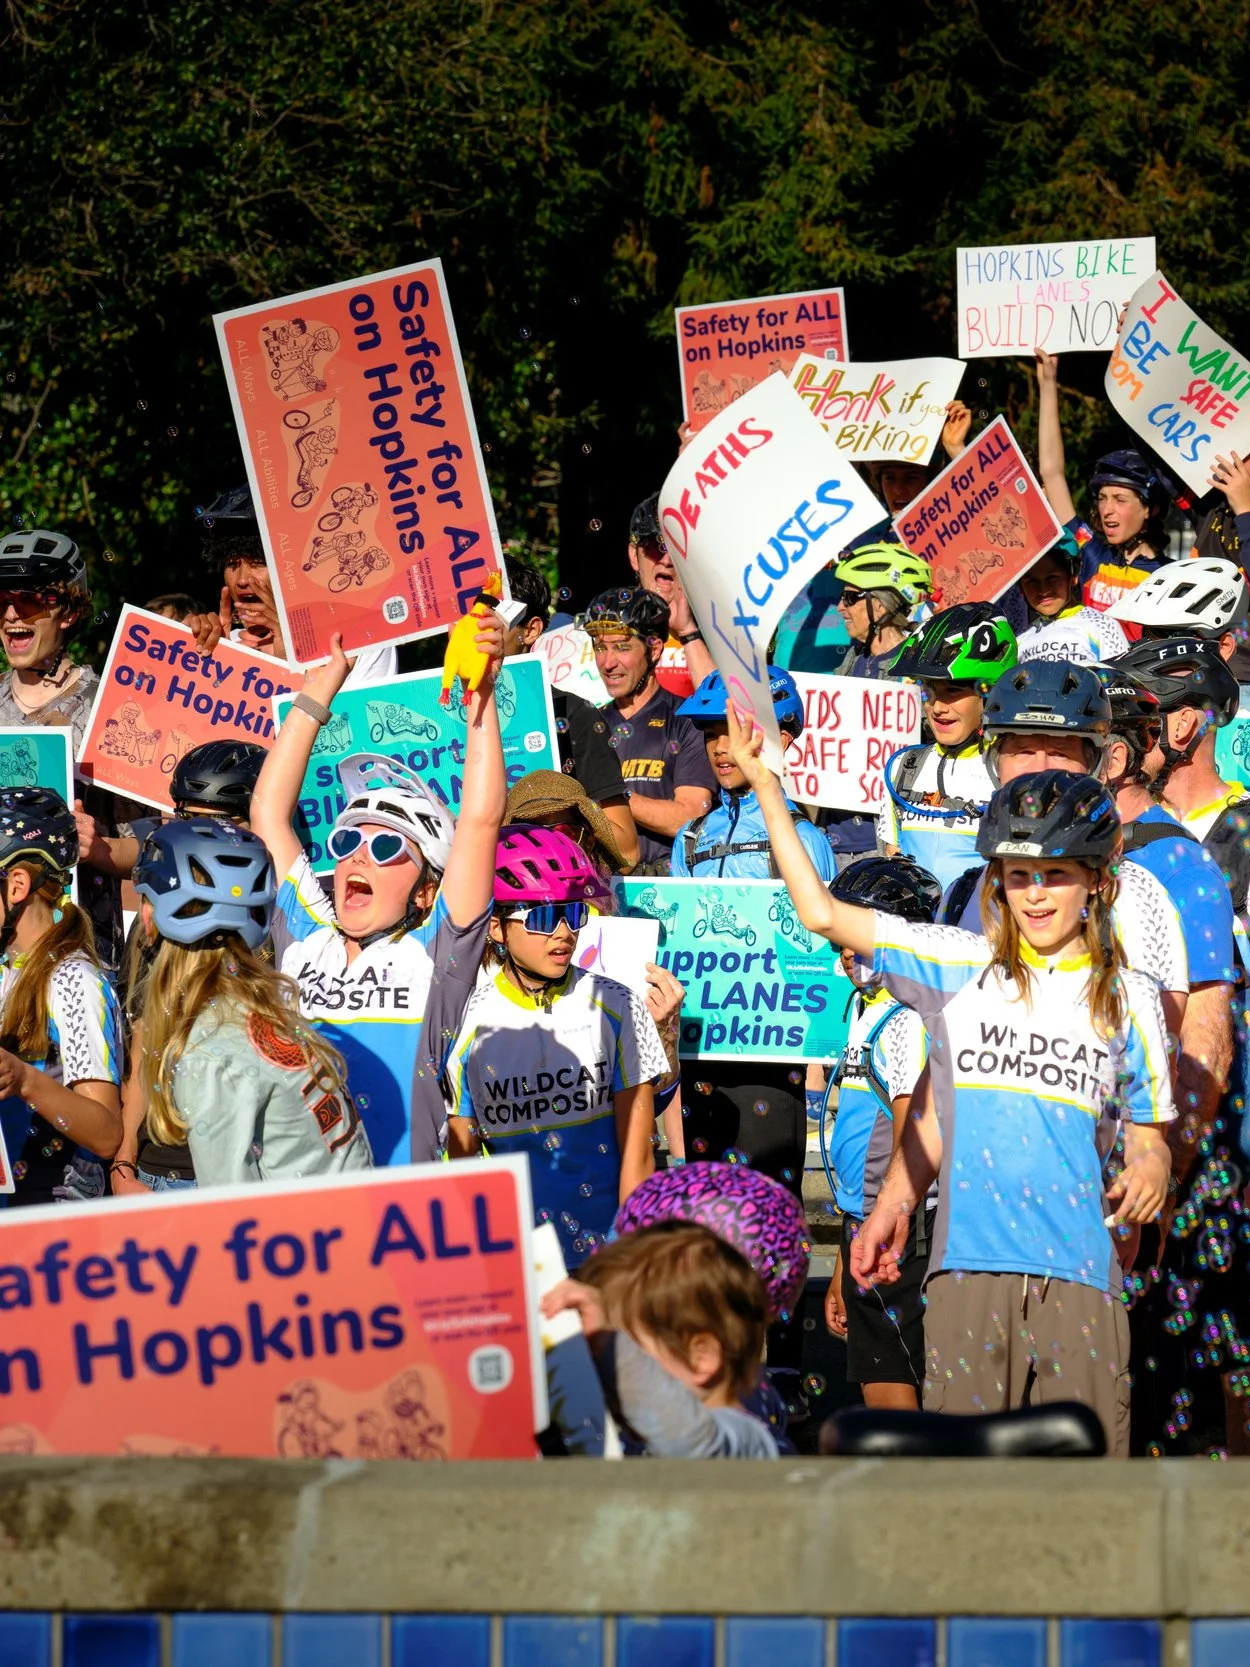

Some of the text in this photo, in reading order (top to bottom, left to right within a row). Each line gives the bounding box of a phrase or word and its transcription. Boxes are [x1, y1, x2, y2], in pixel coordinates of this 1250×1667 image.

[965, 243, 1137, 285] HOPKINS BIKE
[1016, 280, 1091, 305] LANES
[1141, 279, 1177, 325] I
[683, 300, 839, 337] Safety for ALL
[966, 304, 1055, 352] BUILD
[686, 346, 710, 362] on
[717, 331, 806, 360] Hopkins
[235, 339, 256, 403] ALL Ways
[1123, 320, 1240, 430] BE SAFE
[899, 381, 931, 415] if
[349, 293, 426, 555] on Hopkins
[1148, 403, 1211, 463] CARS
[393, 279, 486, 615] Safety for ALL
[255, 428, 280, 510] ALL Abilities
[661, 417, 774, 560] DEATHS
[902, 492, 951, 545] Safety
[951, 466, 975, 497] for
[977, 433, 1011, 473] ALL
[919, 543, 938, 564] on
[935, 480, 999, 548] Hopkins
[277, 532, 298, 592] ALL Ages
[1214, 588, 1235, 607] SMITH
[124, 624, 293, 699] Safety for
[1022, 641, 1080, 658] WILDCAT
[1158, 643, 1205, 661] FOX
[114, 664, 157, 695] on
[772, 678, 788, 690] GIRO
[1105, 686, 1136, 696] GIRO
[803, 689, 842, 731] IDS
[862, 689, 918, 734] NEED
[621, 759, 666, 778] MTB
[789, 733, 850, 774] SAFE
[789, 771, 820, 798] TO
[22, 828, 42, 841] KALI
[1003, 842, 1030, 853] IAN
[656, 948, 778, 979] upport
[299, 986, 410, 1011] MPOSITE
[700, 980, 829, 1014] LANES
[682, 1015, 805, 1051] opkins
[484, 1060, 608, 1101] WILDCAT
[957, 1048, 1102, 1100] COMPOSIT
[0, 1193, 516, 1309] afety for ALL
[0, 1347, 41, 1396] n
[73, 1293, 406, 1386] Hopkins
